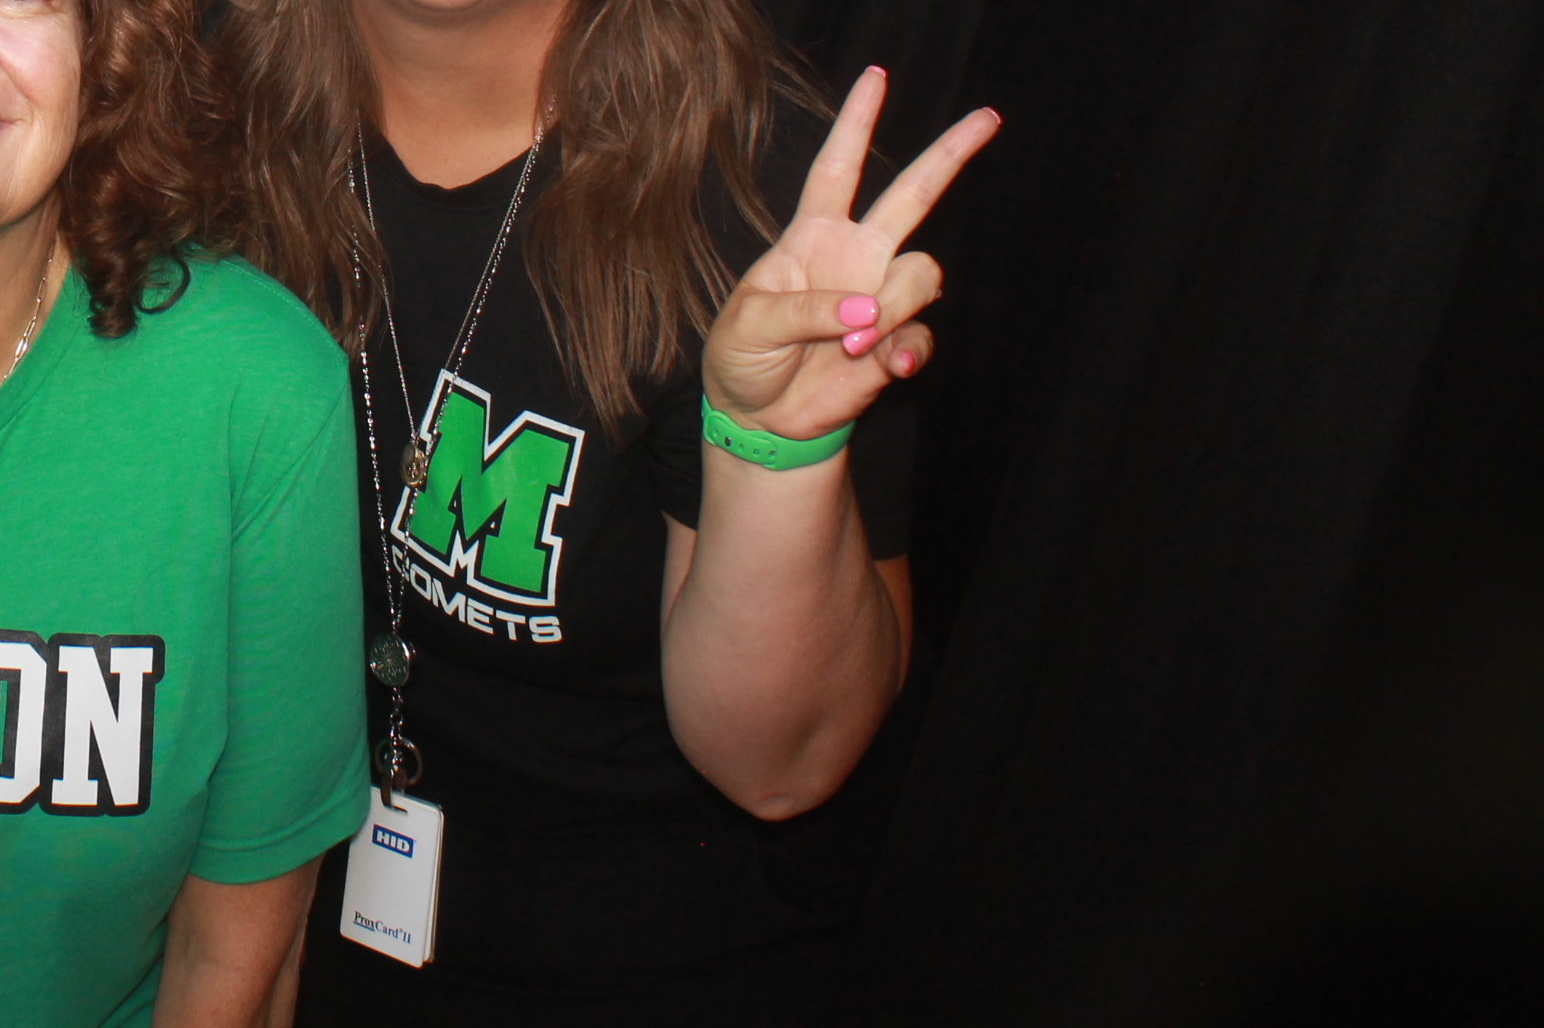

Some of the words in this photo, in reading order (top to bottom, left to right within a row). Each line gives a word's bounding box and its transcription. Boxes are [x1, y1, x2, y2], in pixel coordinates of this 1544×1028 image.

[390, 368, 586, 607] M
[391, 544, 563, 643] COMETS
[375, 828, 412, 854] HID
